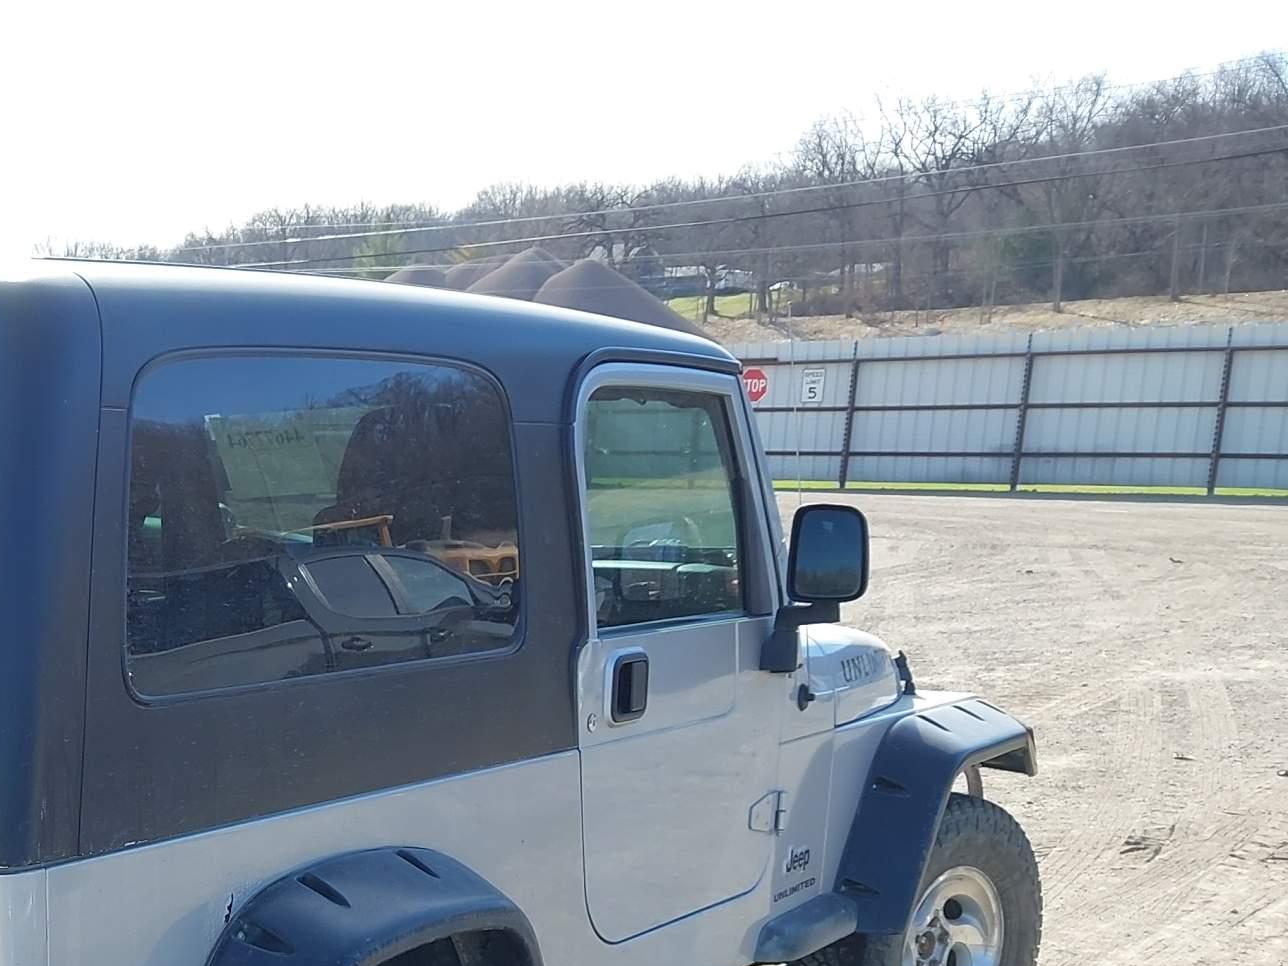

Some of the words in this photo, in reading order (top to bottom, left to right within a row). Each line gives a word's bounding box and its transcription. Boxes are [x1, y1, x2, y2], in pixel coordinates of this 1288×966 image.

[743, 379, 767, 392] TOP
[807, 386, 817, 399] 5
[785, 848, 810, 873] Jeep
[773, 877, 816, 902] UNLIMITED
